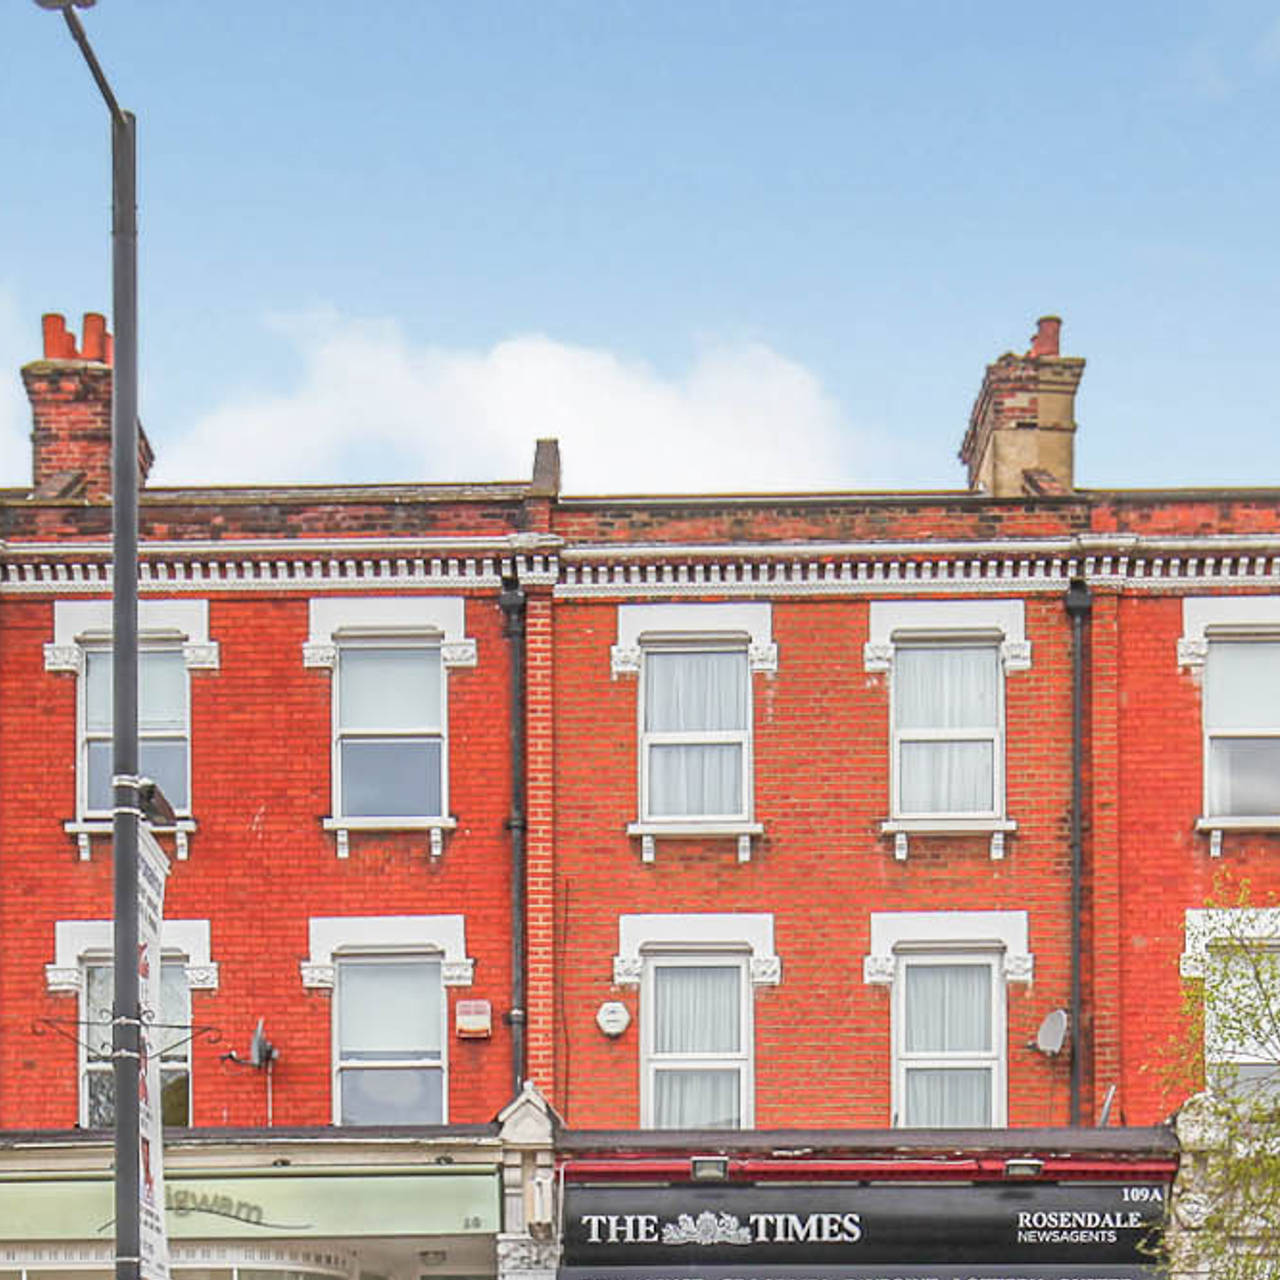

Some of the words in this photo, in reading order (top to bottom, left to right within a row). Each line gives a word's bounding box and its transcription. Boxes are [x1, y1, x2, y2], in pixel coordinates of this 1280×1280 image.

[162, 1183, 264, 1224] igwam
[1121, 1188, 1163, 1202] 109A
[581, 1214, 658, 1243] THE
[749, 1213, 861, 1243] TIMES
[1018, 1211, 1142, 1229] ROSENDALE
[1018, 1230, 1118, 1244] NEWSAGENTS
